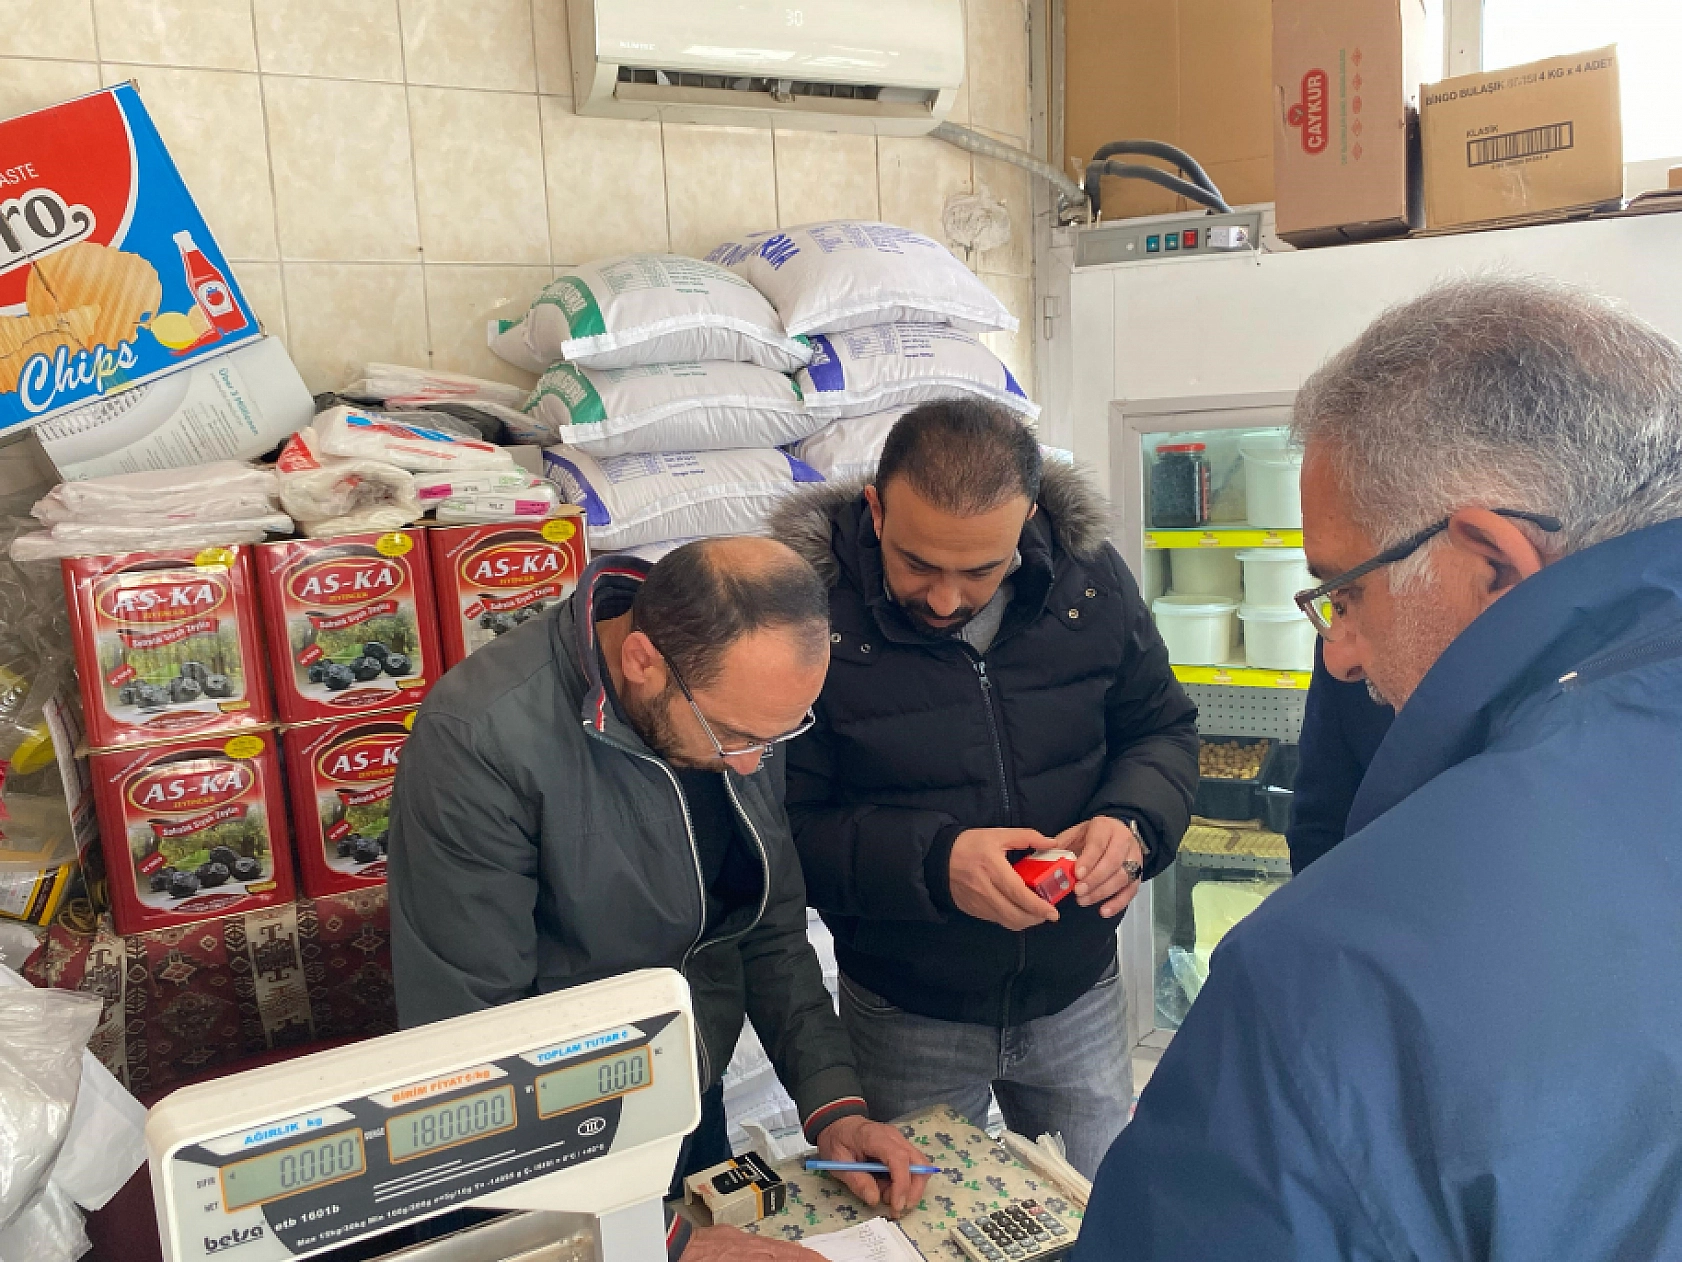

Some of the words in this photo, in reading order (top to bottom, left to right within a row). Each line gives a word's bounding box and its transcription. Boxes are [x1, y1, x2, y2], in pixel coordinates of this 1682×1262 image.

[786, 9, 803, 27] 30
[1538, 71, 1545, 81] 4
[1547, 68, 1565, 79] KG
[1575, 64, 1582, 73] 4
[1584, 57, 1614, 72] ADET
[1307, 74, 1324, 149] ÇAYKUR
[19, 341, 138, 413] Chips
[473, 553, 559, 580] AS-KA
[300, 567, 394, 597] AS-KA
[112, 584, 215, 614] AS-KA
[331, 746, 401, 775] AS-K
[142, 770, 244, 805] AS-KA
[537, 1043, 582, 1062] TOPLAM
[585, 1032, 619, 1049] TUTAR
[392, 1085, 427, 1103] BİRİM
[430, 1075, 463, 1092] FİYAT
[599, 1055, 643, 1095] 0.00
[244, 1121, 299, 1145] AĞIRLIK
[307, 1116, 323, 1128] kg
[412, 1094, 505, 1149] 1800.00
[280, 1138, 354, 1188] 0.000
